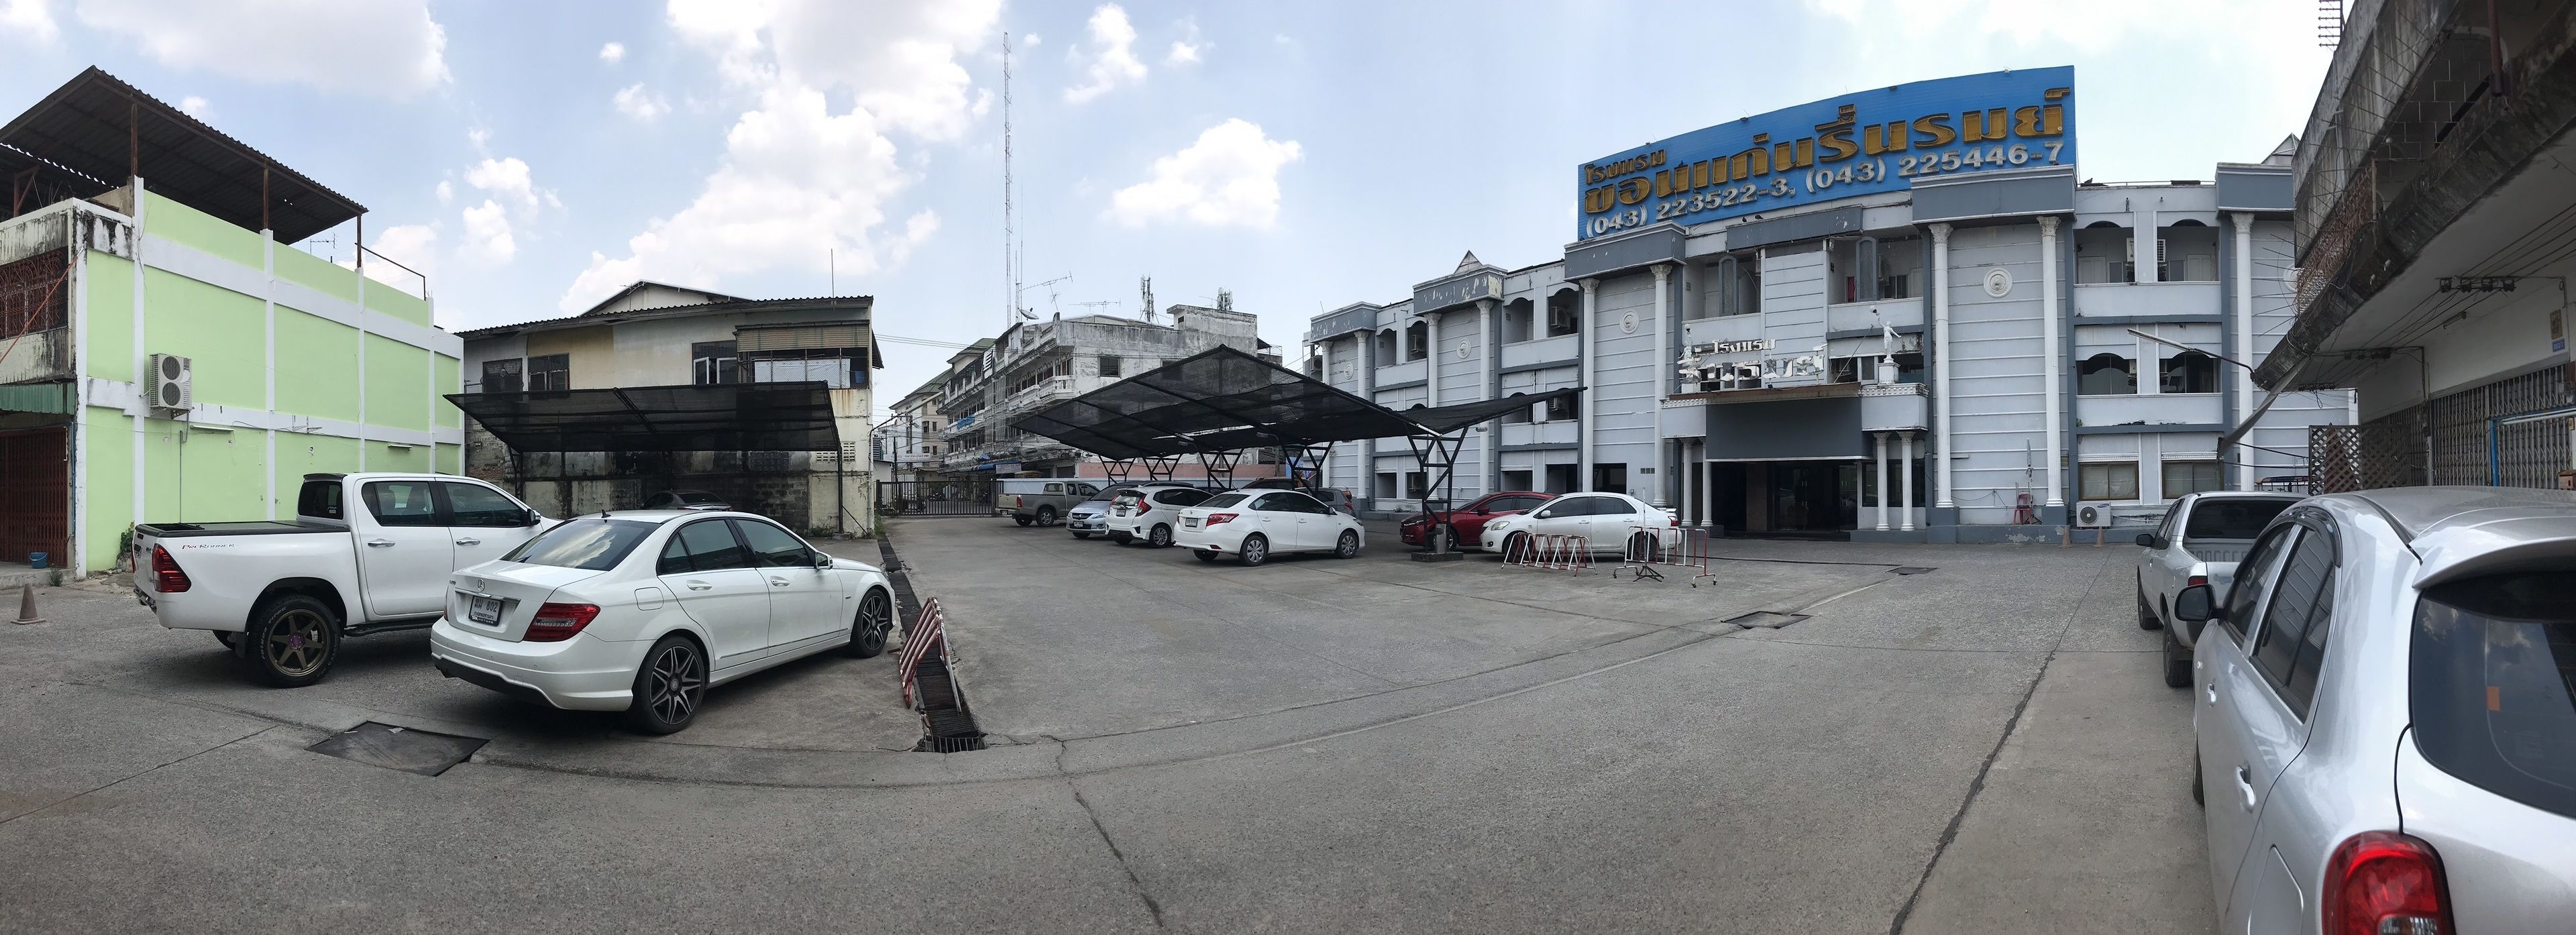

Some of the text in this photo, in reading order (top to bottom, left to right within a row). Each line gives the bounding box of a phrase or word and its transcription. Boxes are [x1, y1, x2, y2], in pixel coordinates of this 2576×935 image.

[1585, 149, 1666, 184] โรงแรม
[1586, 141, 2064, 237] (043) 223522-3, (043) 225446-7
[1712, 339, 1776, 353] โรงแรม
[486, 600, 498, 612] 802
